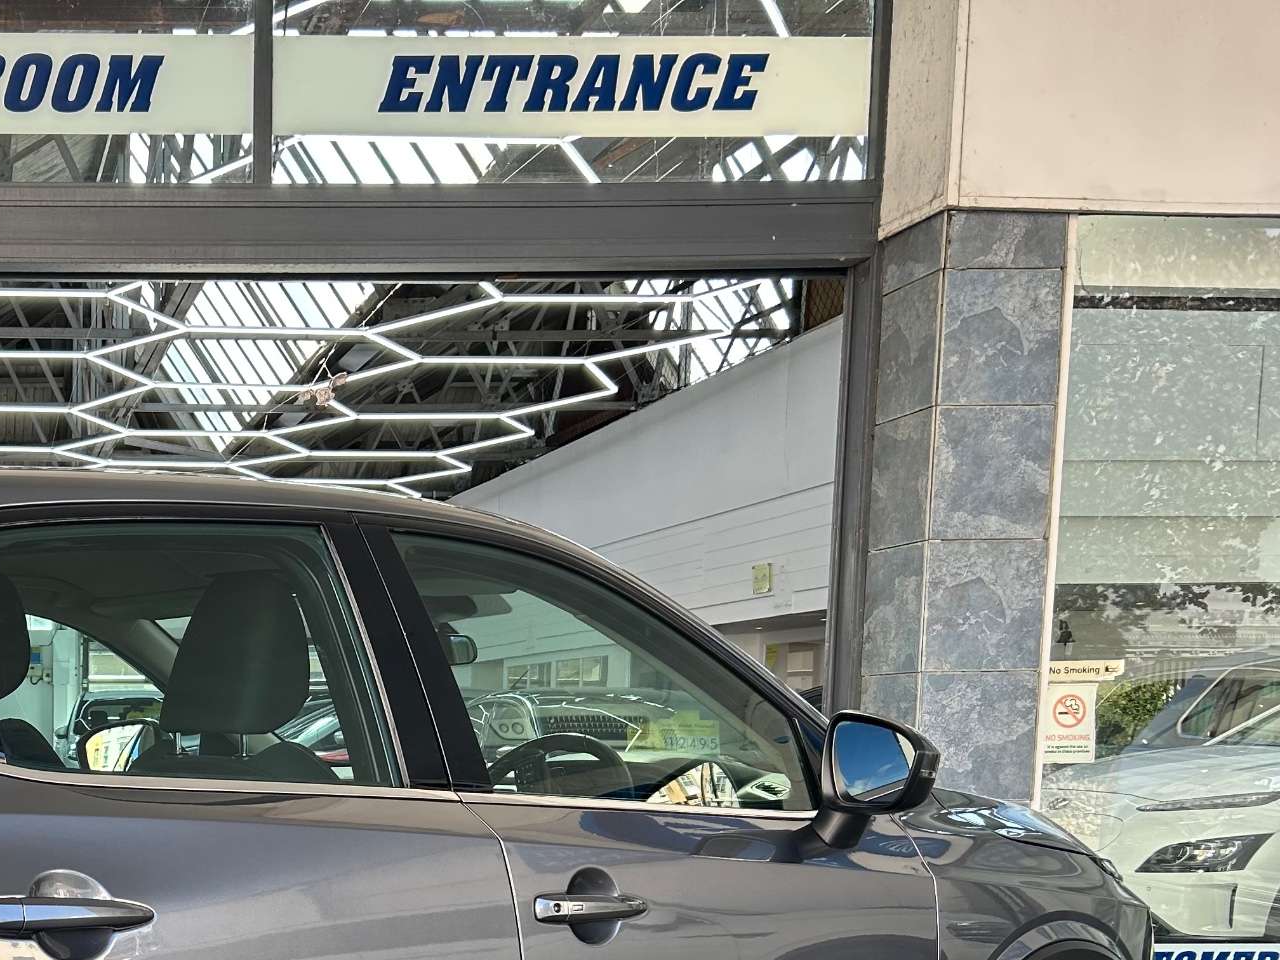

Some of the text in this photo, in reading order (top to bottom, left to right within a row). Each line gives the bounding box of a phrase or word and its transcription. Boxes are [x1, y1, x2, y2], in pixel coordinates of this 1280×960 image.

[377, 52, 770, 113] ENTRANCE
[1049, 666, 1100, 675] No Smoking
